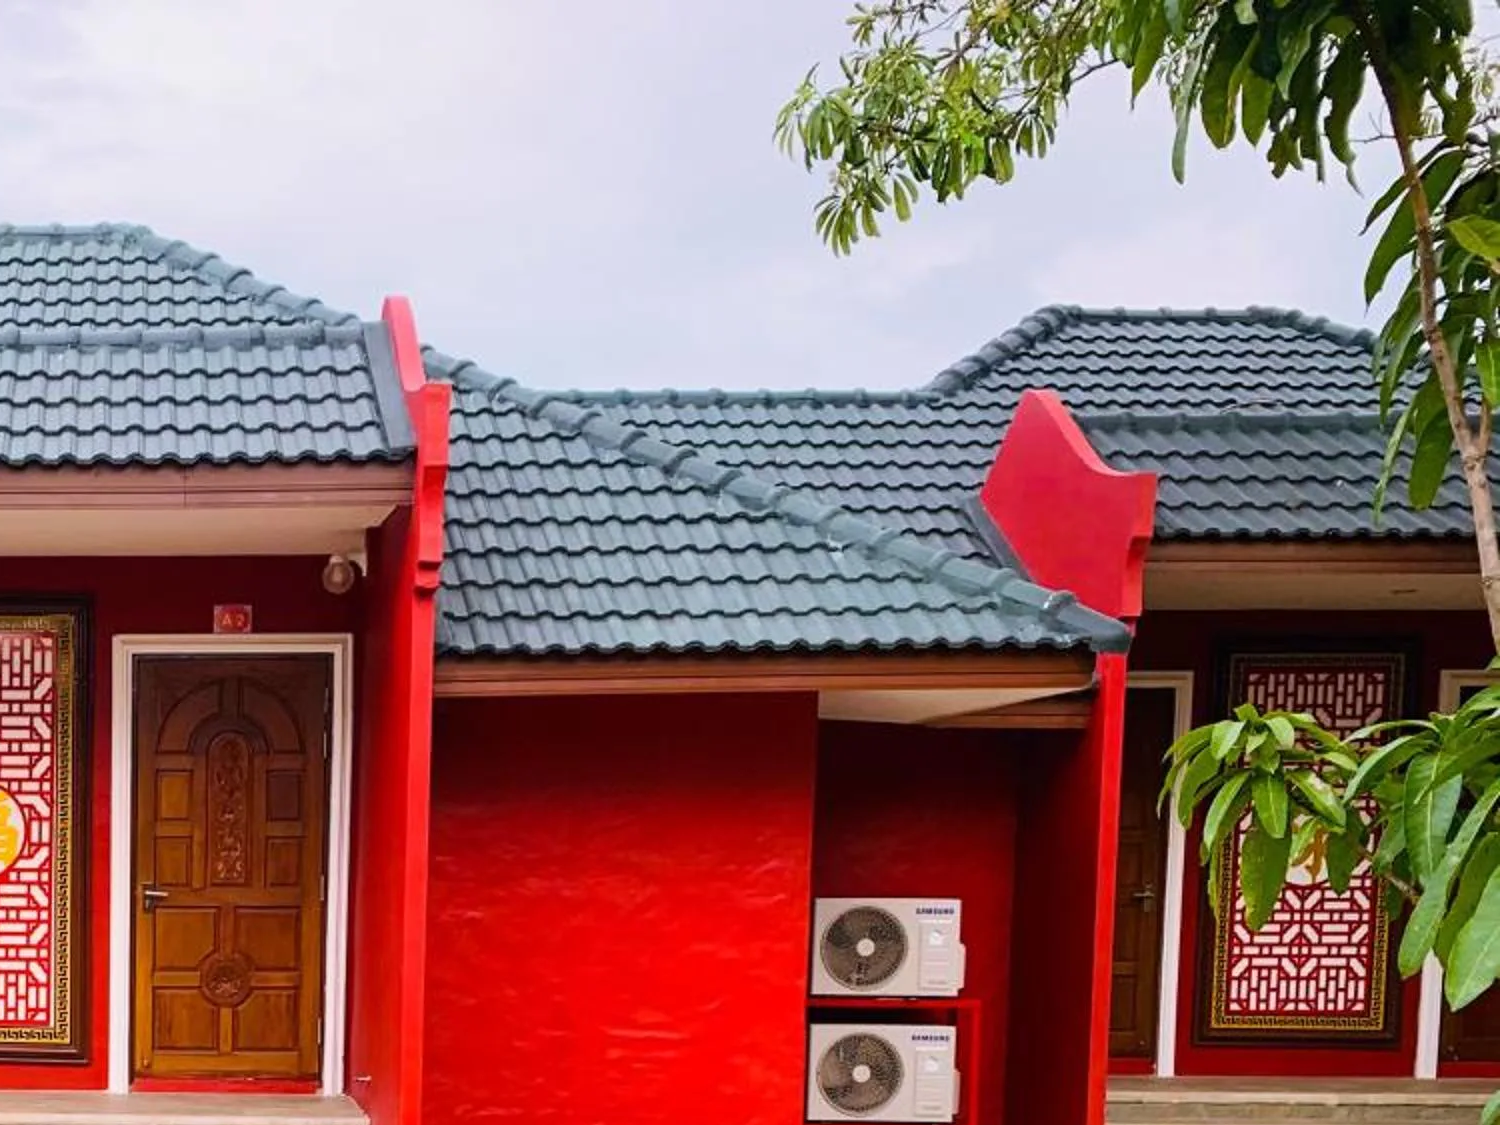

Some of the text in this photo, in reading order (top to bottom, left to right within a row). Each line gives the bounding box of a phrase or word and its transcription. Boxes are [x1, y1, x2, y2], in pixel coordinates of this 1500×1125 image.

[222, 613, 245, 627] A2
[915, 907, 955, 915] SAMSUNG
[911, 1034, 950, 1042] SAMSUNG
